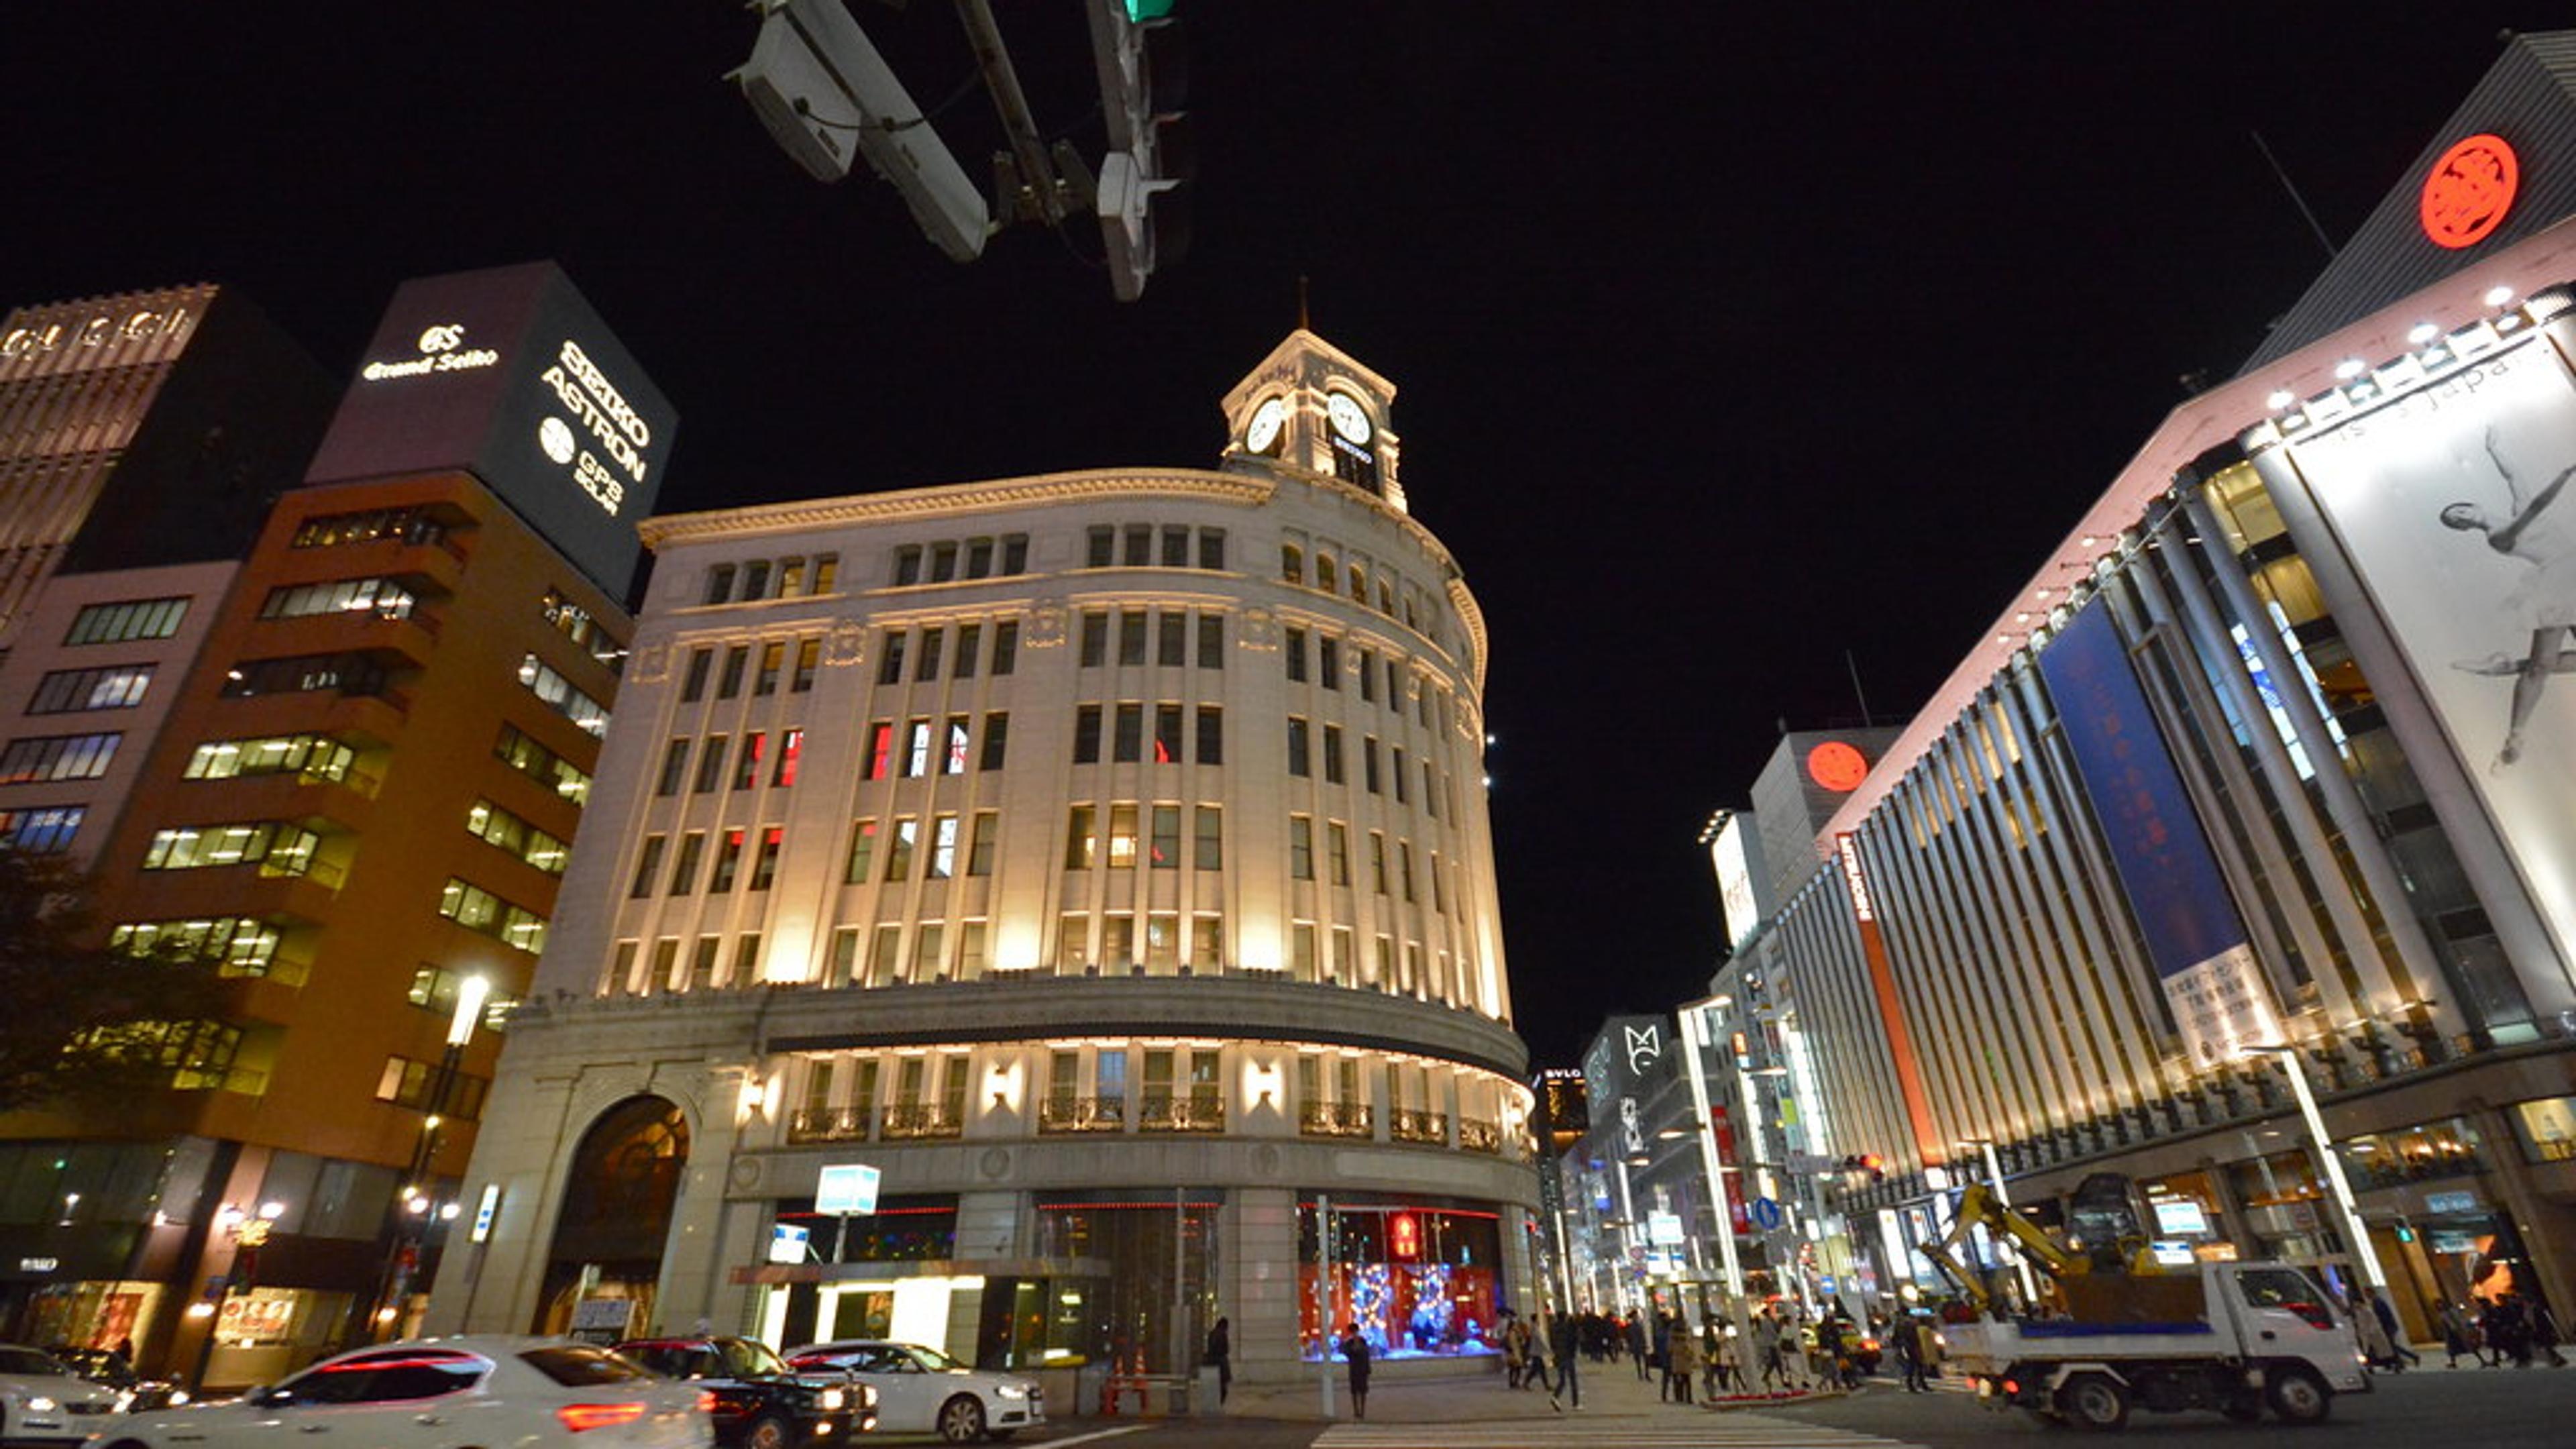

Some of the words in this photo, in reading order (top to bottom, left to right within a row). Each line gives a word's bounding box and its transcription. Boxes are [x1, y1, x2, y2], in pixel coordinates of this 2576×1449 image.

[362, 356, 435, 380] Grand
[435, 350, 498, 371] Seiko
[560, 339, 649, 447] SEIKO
[541, 366, 646, 482] ASTRON
[574, 468, 618, 517] SOLAR
[579, 450, 624, 503] GPS
